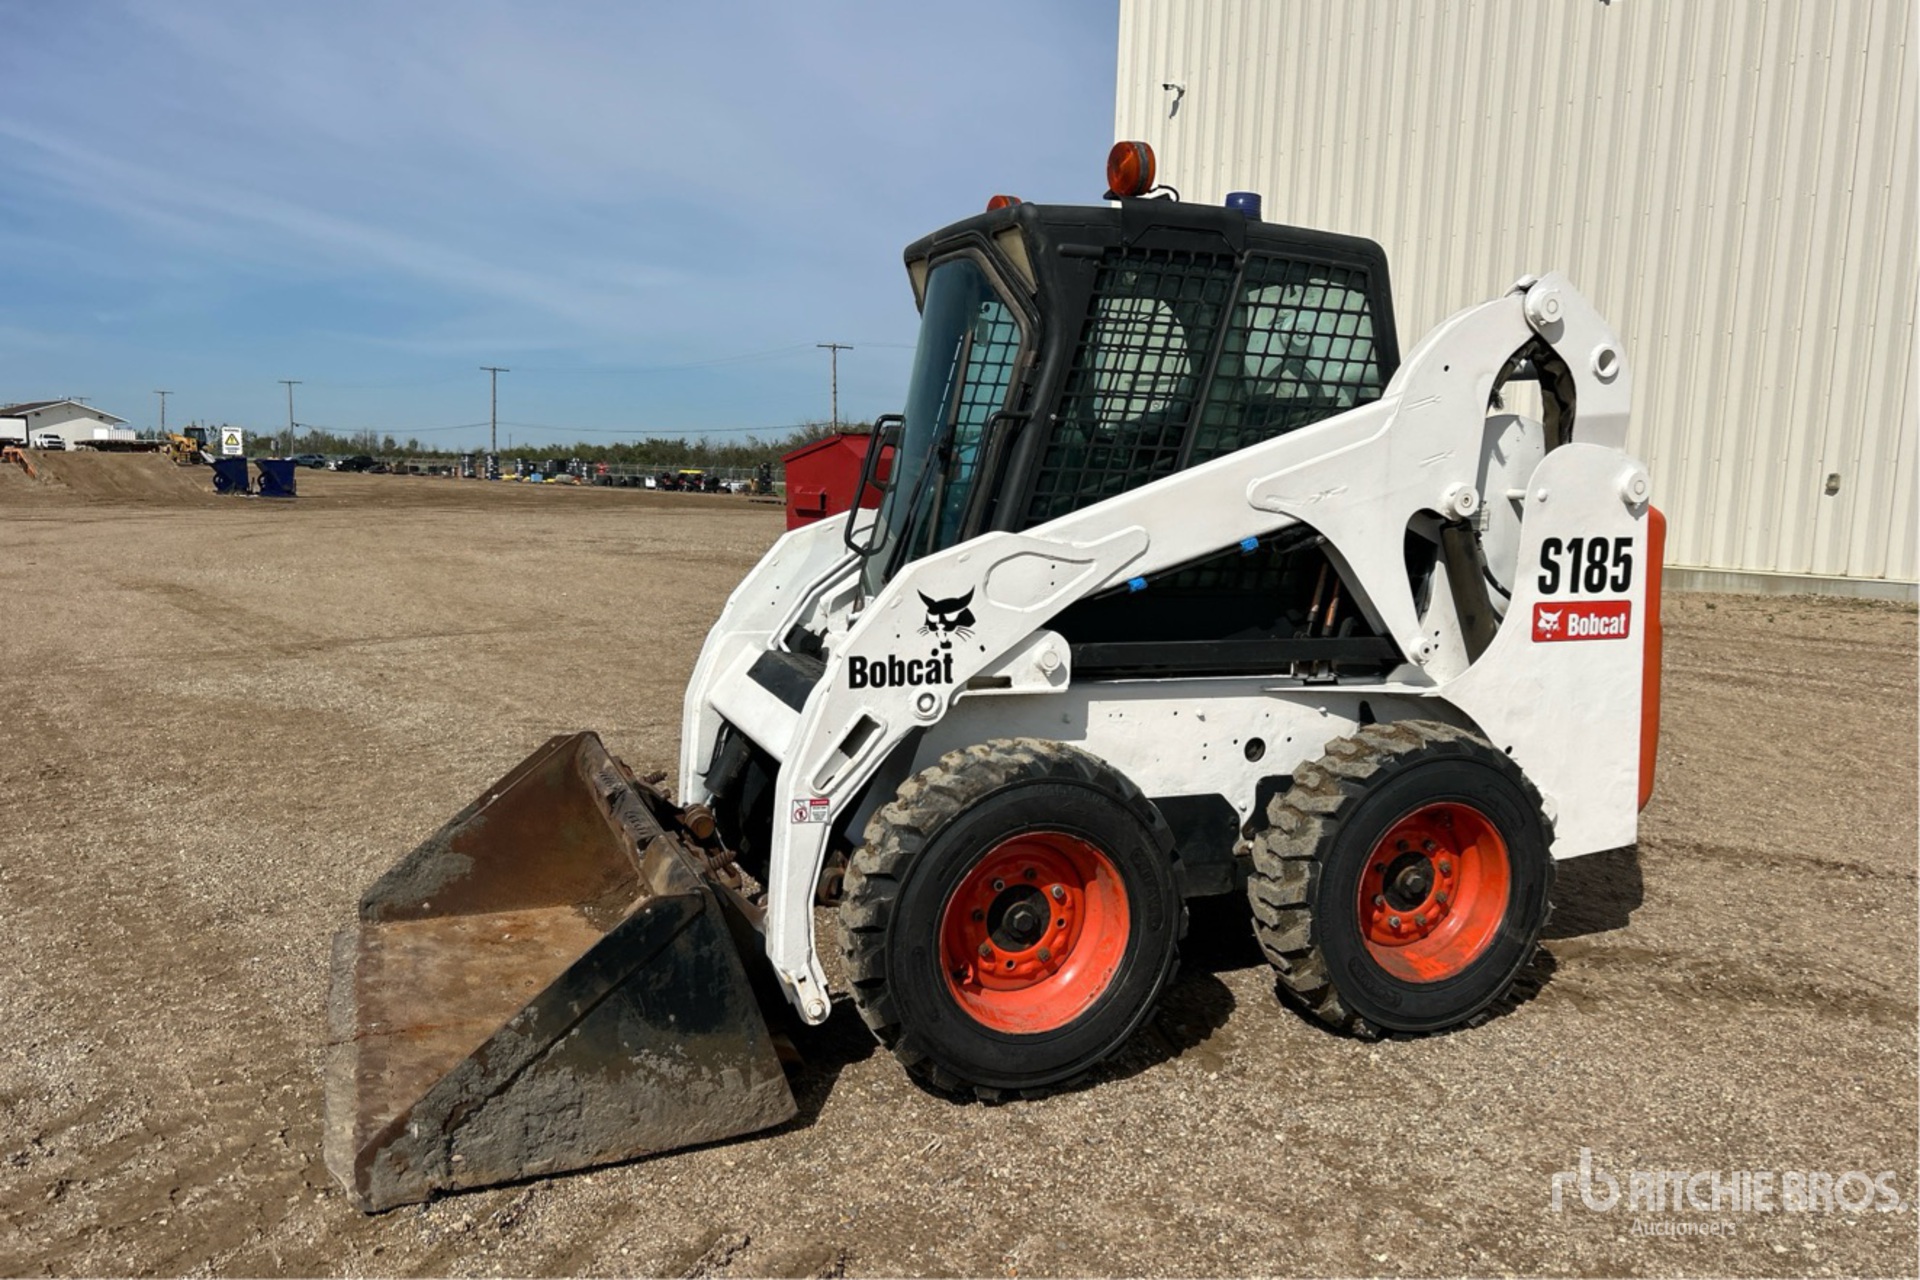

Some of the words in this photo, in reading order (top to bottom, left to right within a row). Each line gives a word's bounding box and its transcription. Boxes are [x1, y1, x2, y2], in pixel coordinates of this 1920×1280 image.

[1538, 537, 1633, 594] S185
[1567, 612, 1626, 636] Bobcat
[849, 653, 953, 689] Bobcat
